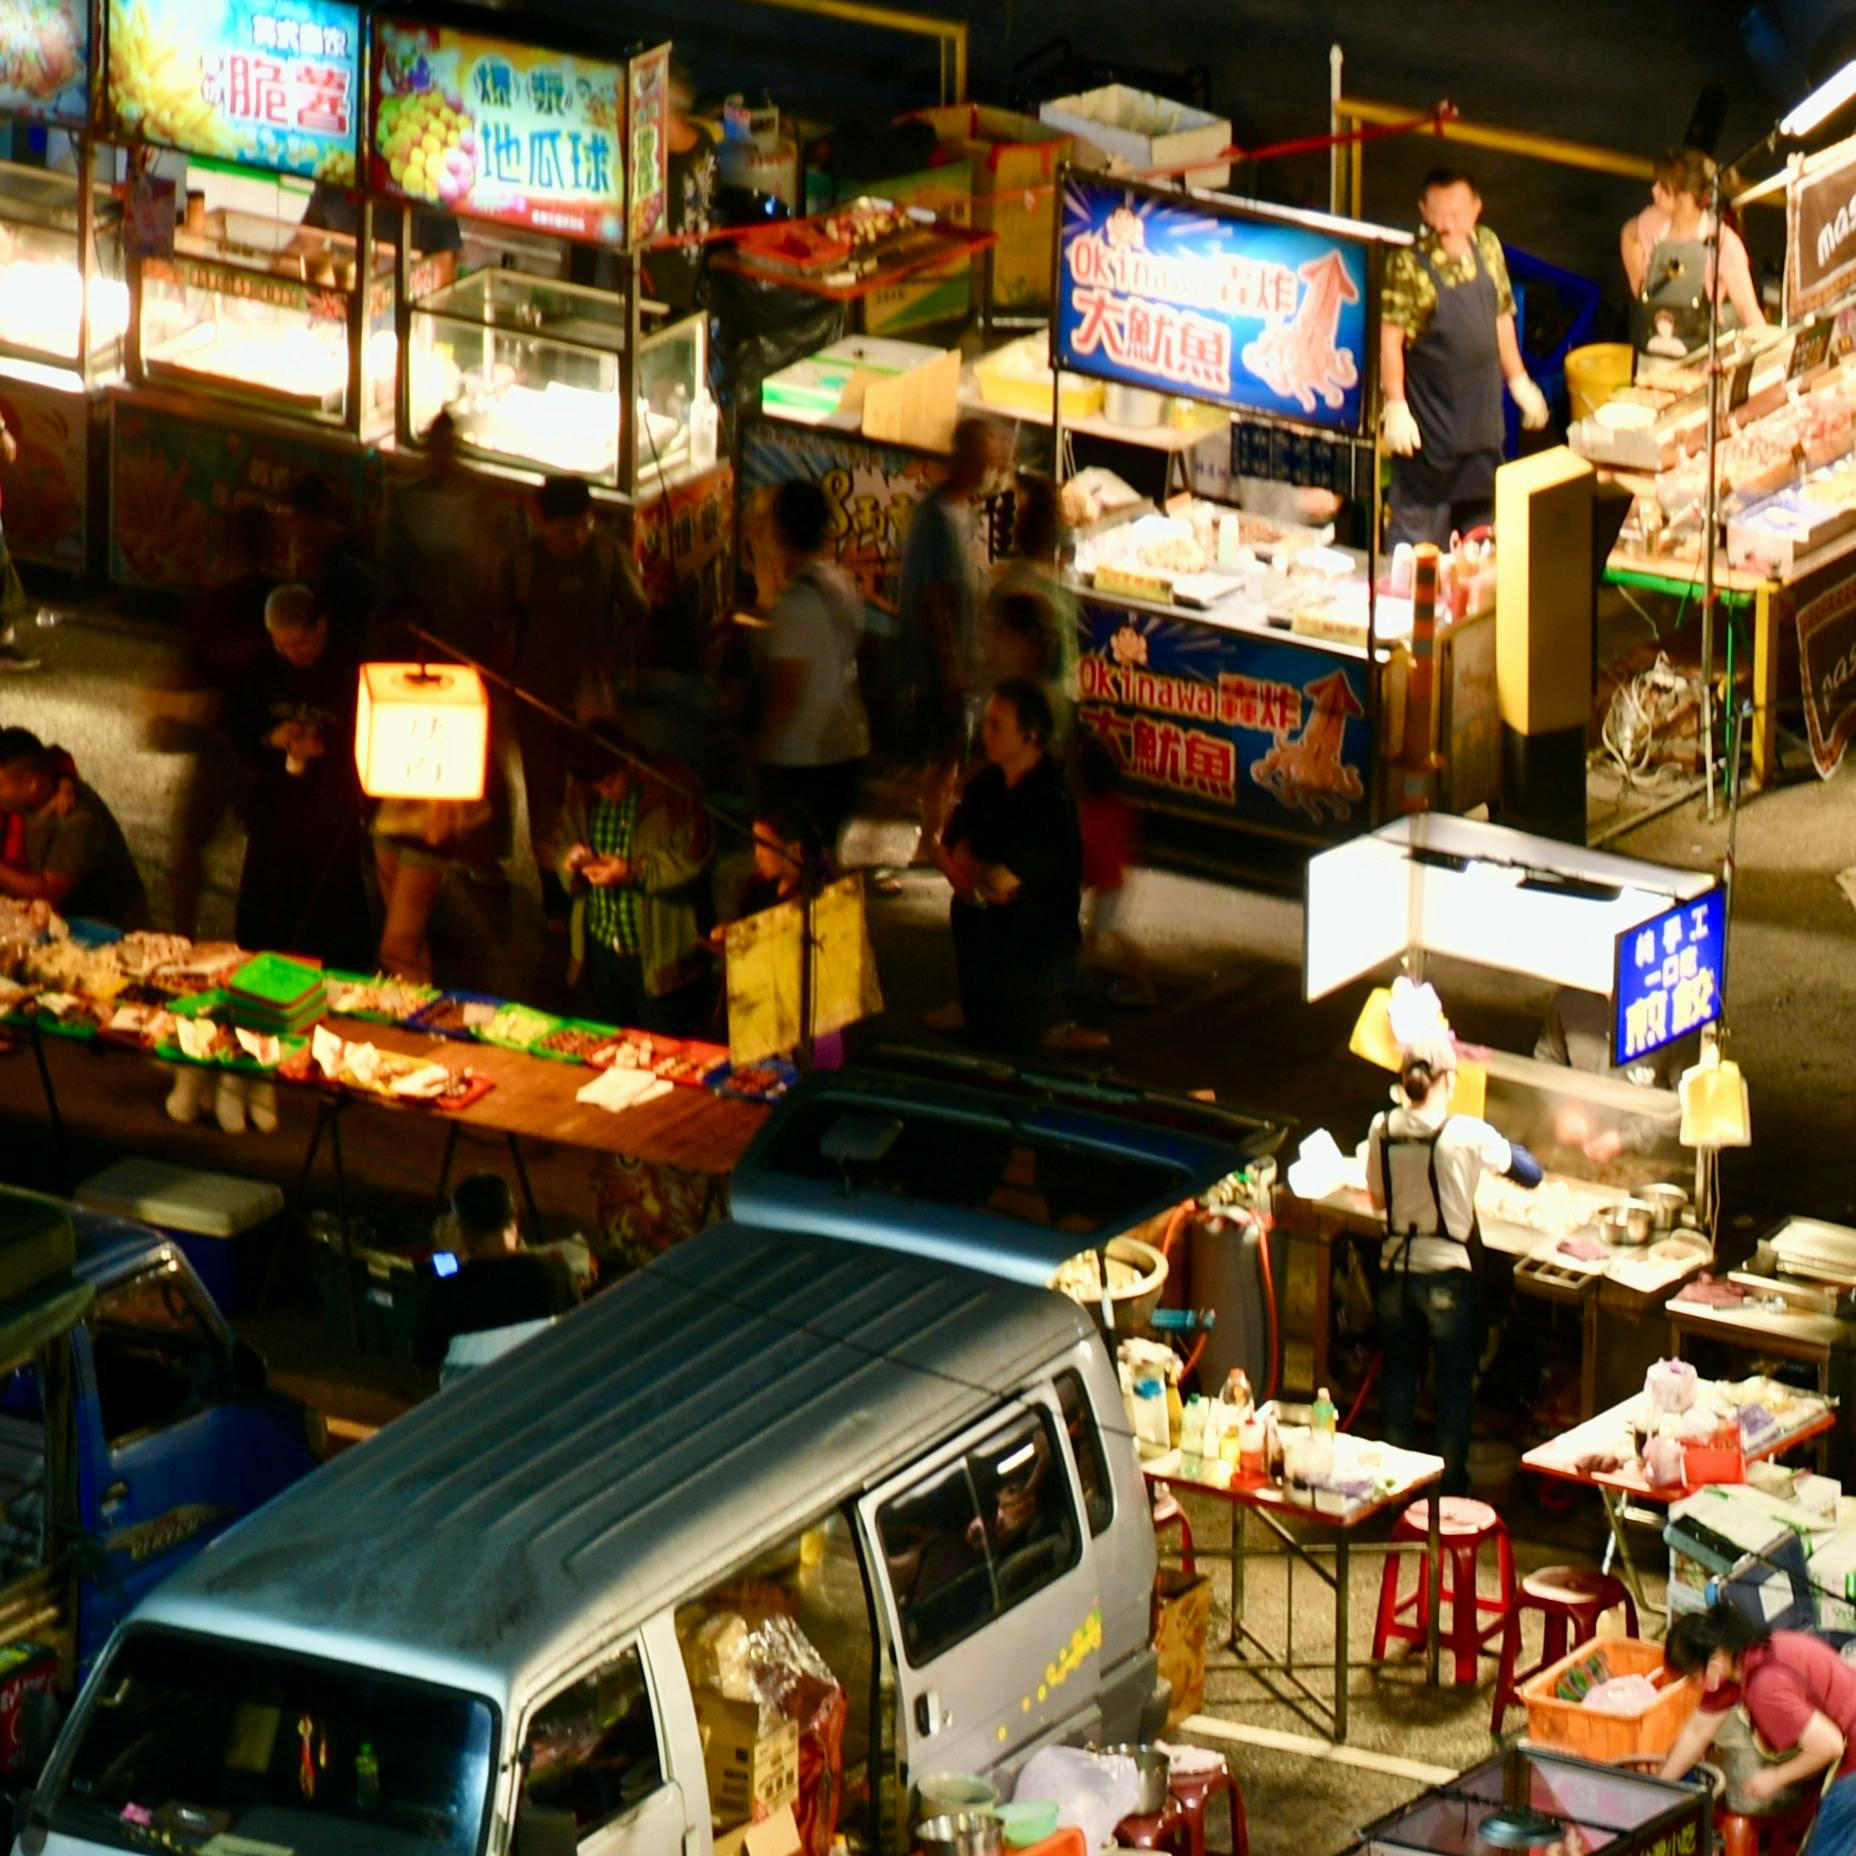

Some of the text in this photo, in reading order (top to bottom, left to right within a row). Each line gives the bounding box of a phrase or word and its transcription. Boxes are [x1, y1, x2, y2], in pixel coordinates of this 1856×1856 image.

[229, 54, 348, 135] 脆薯
[479, 120, 611, 193] 地瓜球
[1073, 288, 1229, 388] 大魷魚
[1078, 655, 1215, 719] Okinawa
[1079, 705, 1236, 803] 大魷魚
